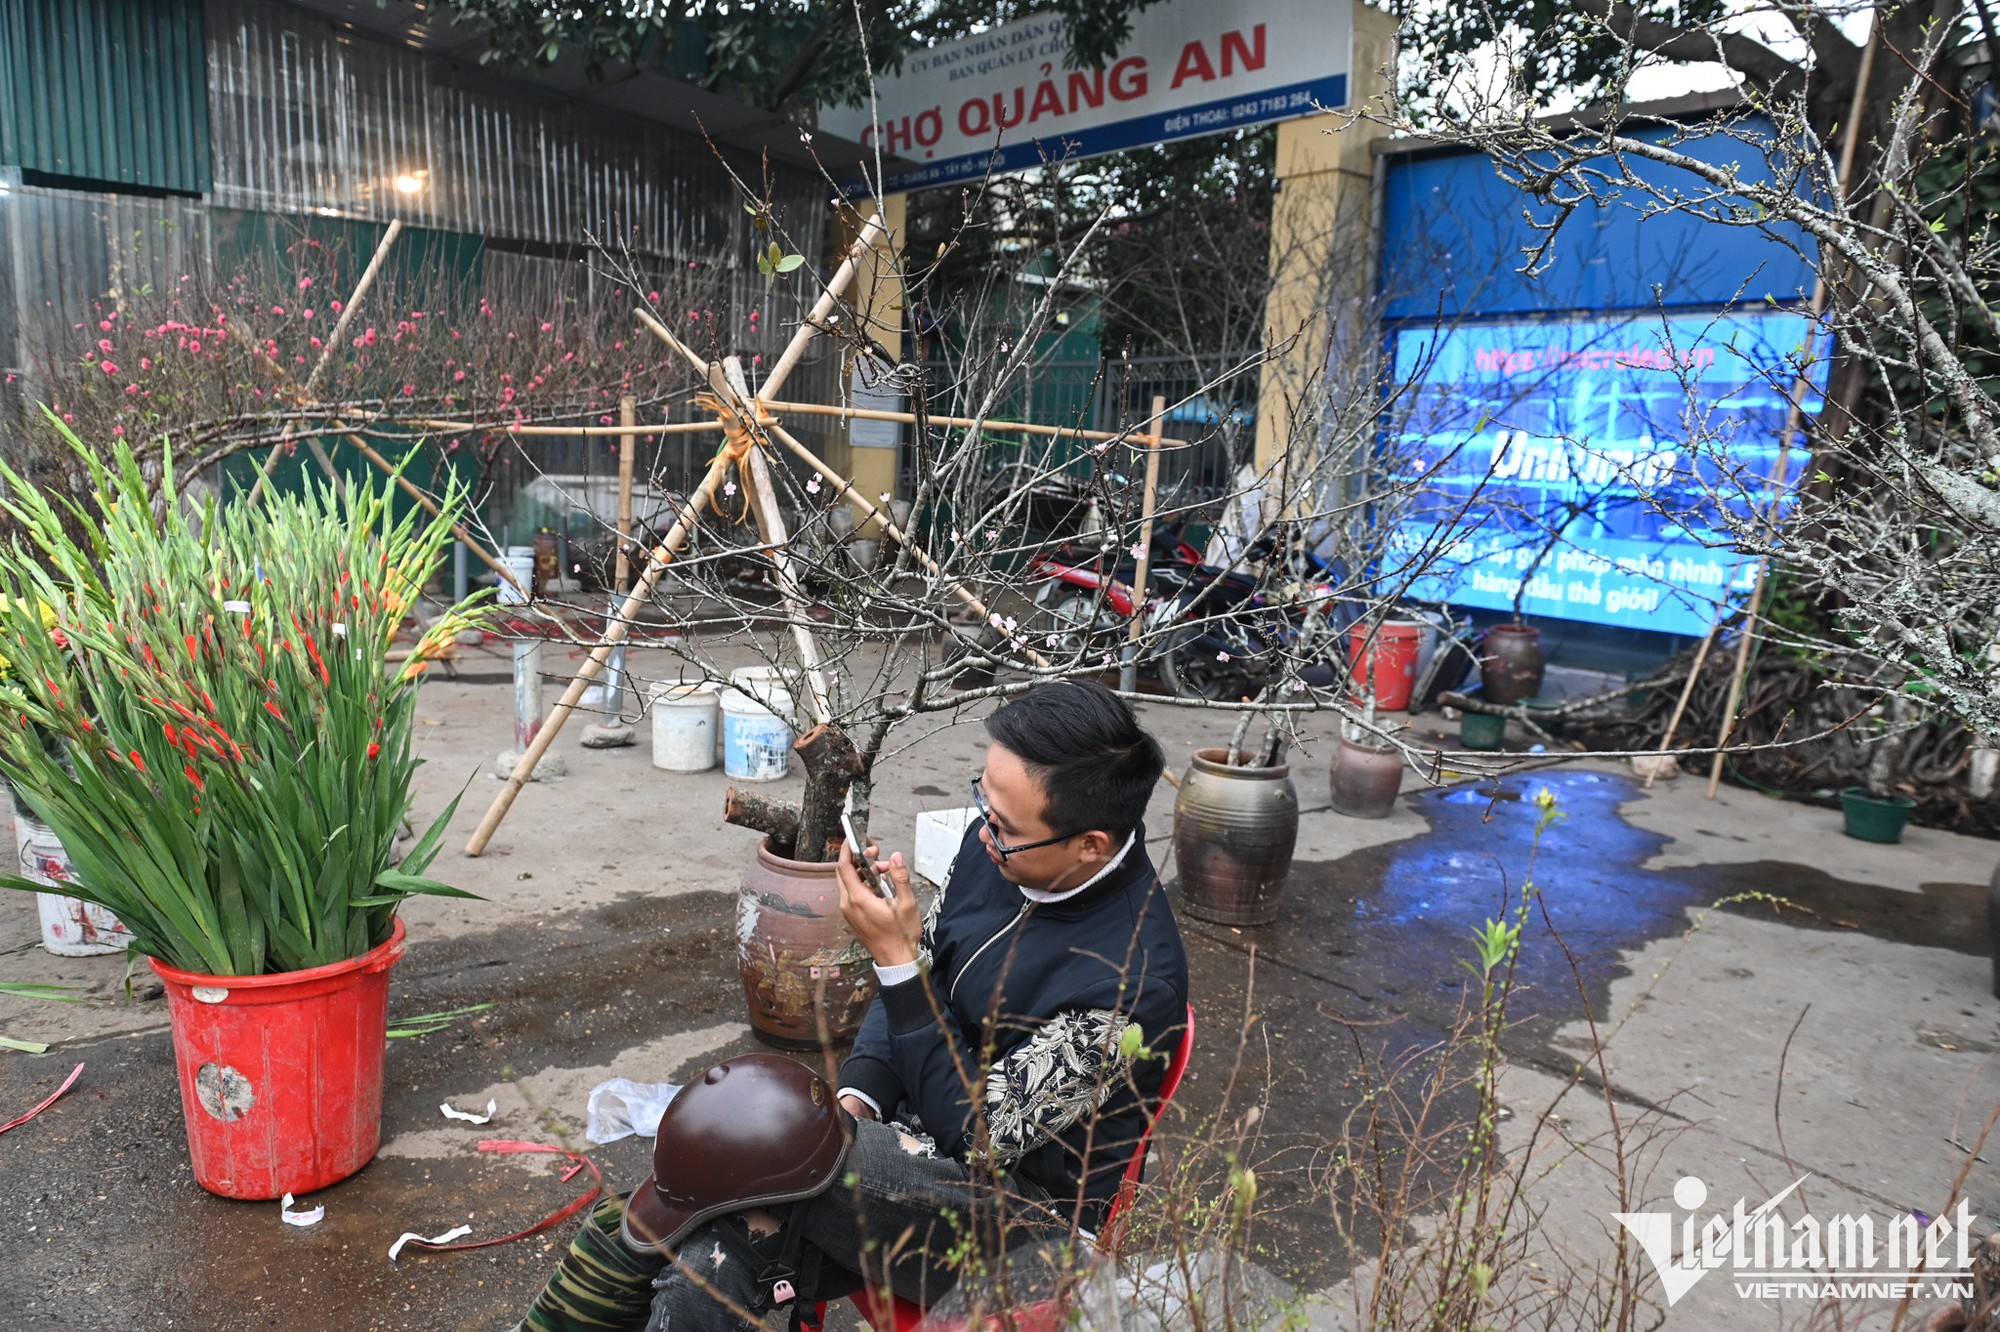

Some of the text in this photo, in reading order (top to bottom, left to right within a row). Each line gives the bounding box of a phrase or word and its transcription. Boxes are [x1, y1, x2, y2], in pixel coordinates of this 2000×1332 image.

[932, 49, 961, 68] BAN
[963, 34, 1007, 60] NHÂN
[1010, 22, 1045, 45] DÂN
[949, 65, 976, 82] BAN
[977, 53, 1015, 76] QUẢN
[860, 22, 1268, 159] CHỢ QUẢNG AN
[1164, 113, 1191, 133] ĐIỆN
[1669, 557, 1724, 586] hình
[1472, 569, 1521, 601] hàng
[1567, 578, 1602, 605] thế
[1605, 585, 1660, 613] giới!
